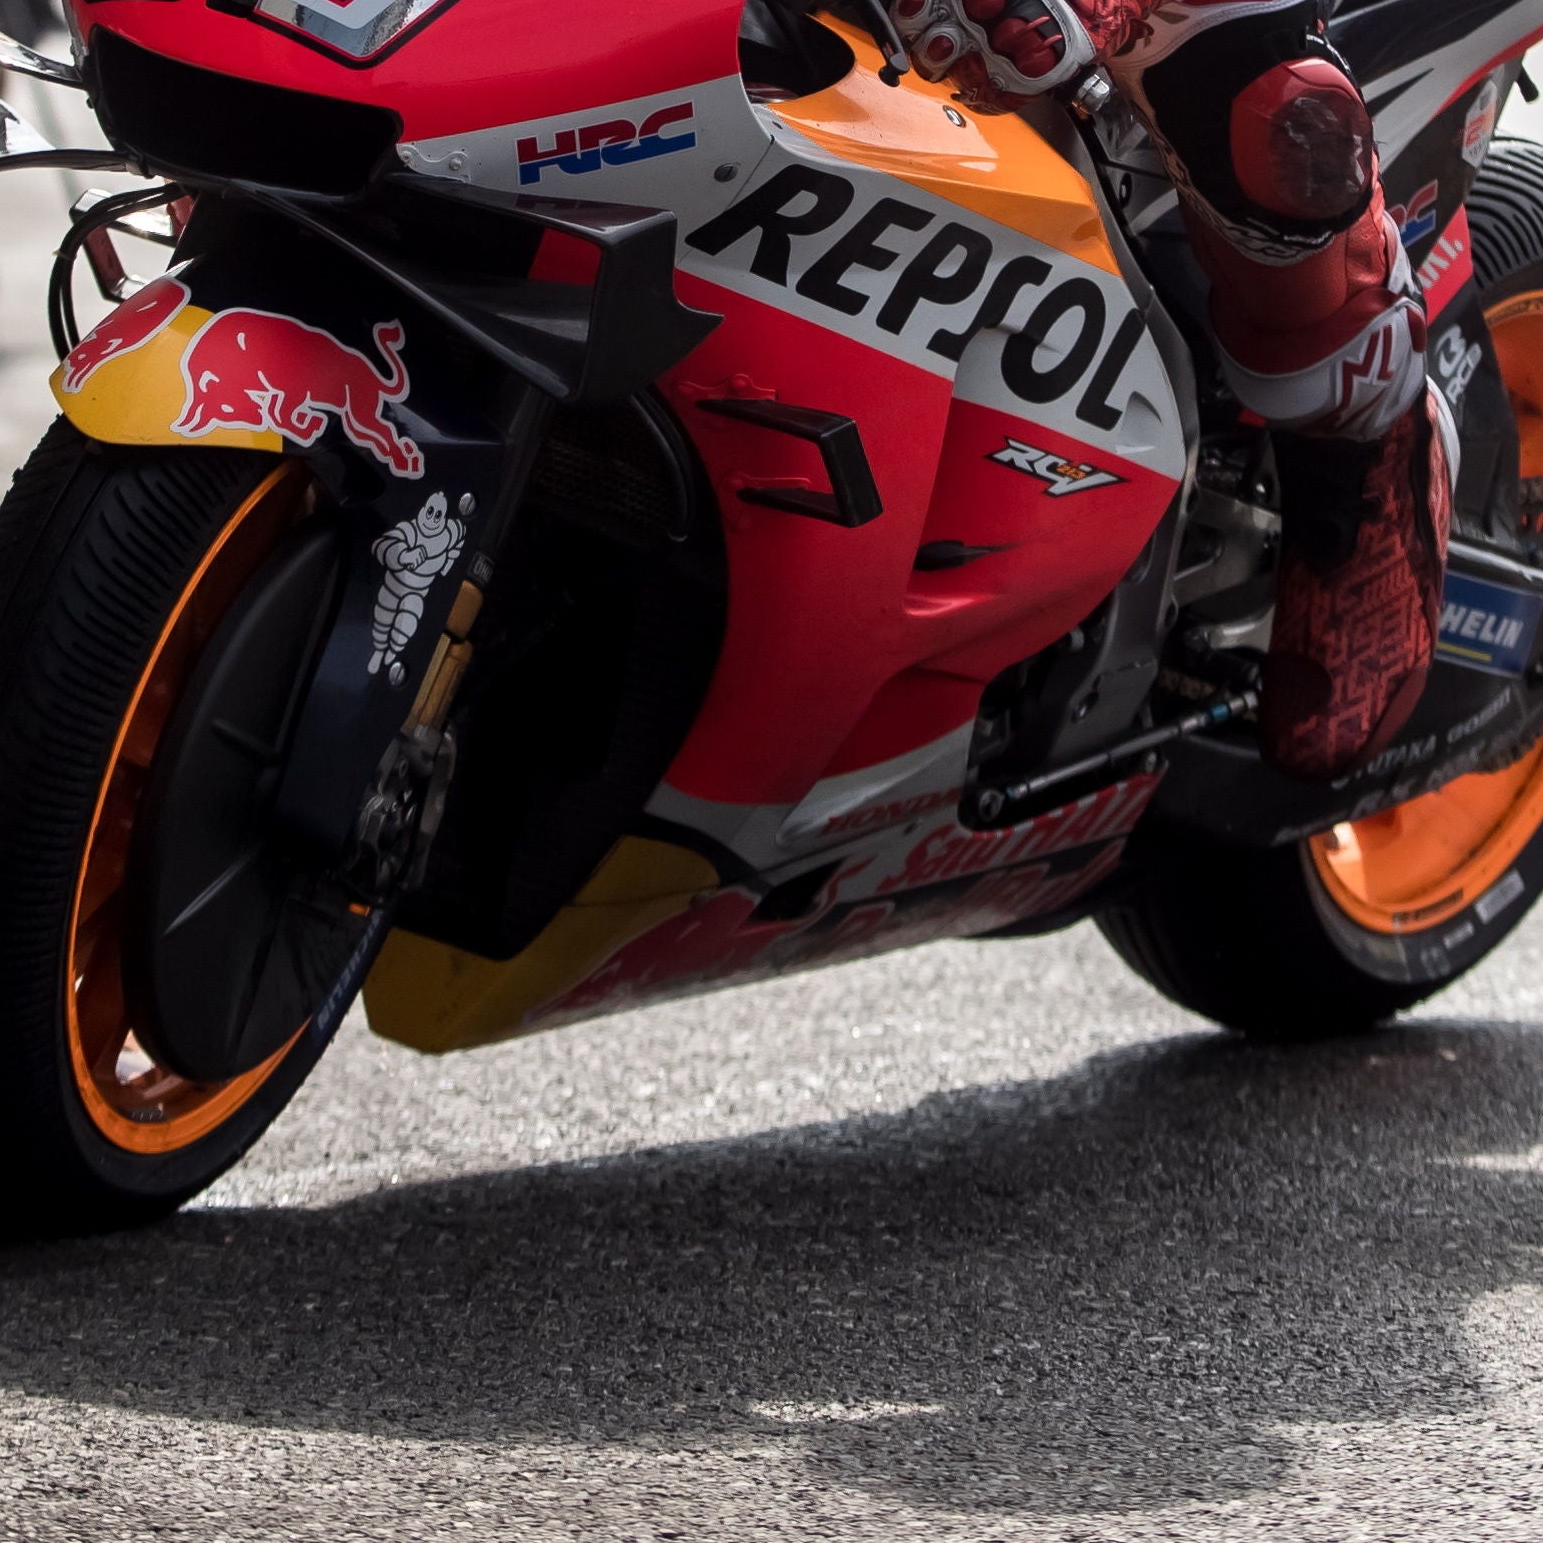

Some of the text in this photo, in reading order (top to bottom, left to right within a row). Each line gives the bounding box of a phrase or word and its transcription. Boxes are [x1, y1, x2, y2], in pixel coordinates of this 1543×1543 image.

[518, 101, 698, 186] HRC
[685, 163, 1148, 431] REPSOL
[1439, 601, 1524, 648] HELIN
